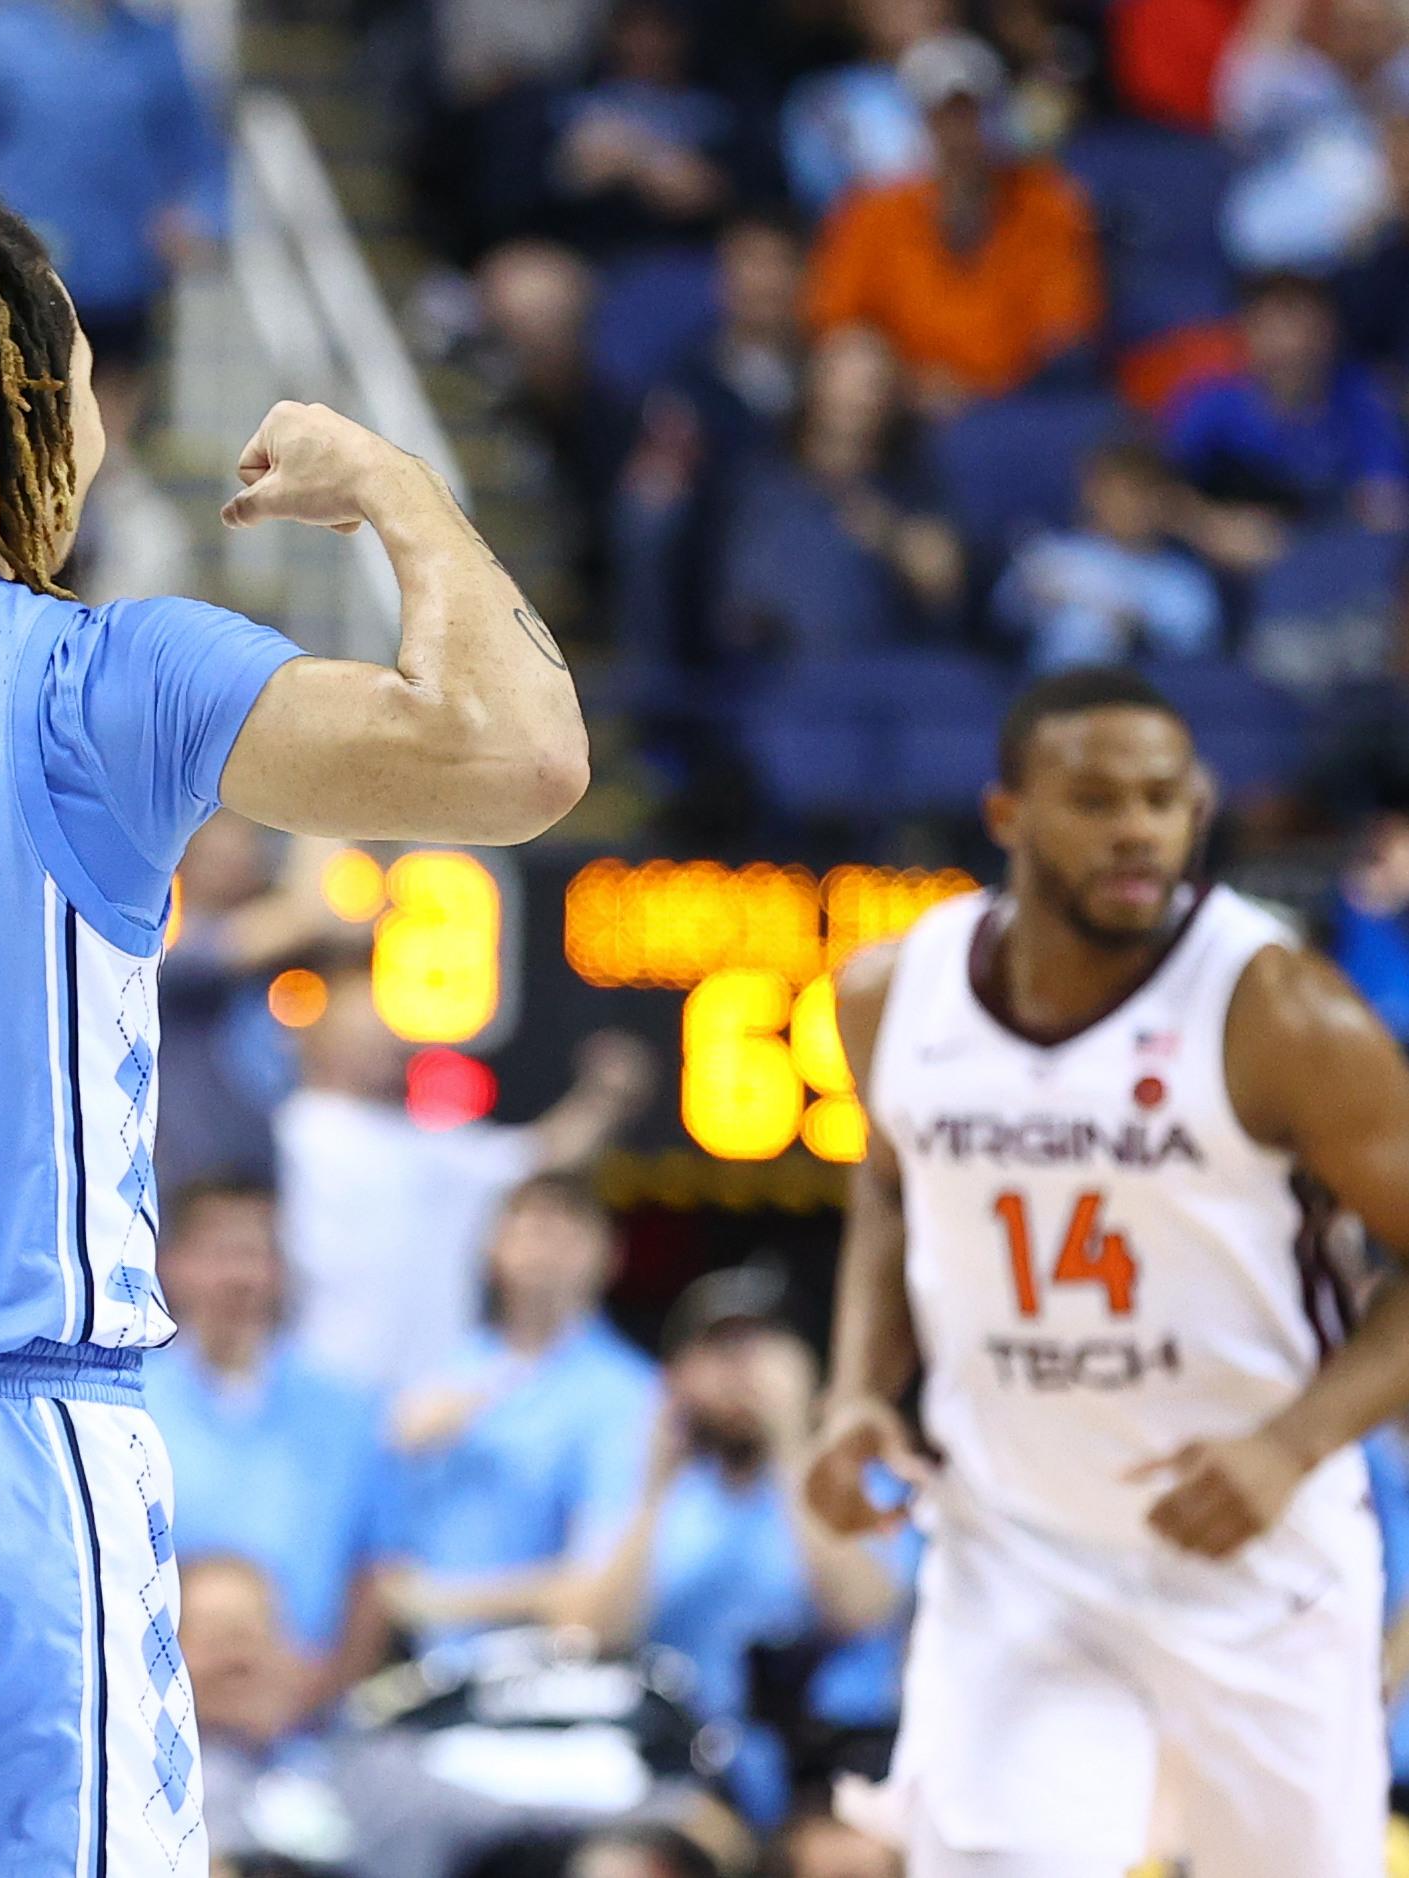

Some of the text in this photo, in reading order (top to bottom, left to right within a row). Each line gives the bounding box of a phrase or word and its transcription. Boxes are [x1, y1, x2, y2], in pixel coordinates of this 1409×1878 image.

[912, 1112, 1203, 1172] VIRGINIA
[994, 1190, 1137, 1319] 14
[986, 1332, 1181, 1393] TECH
